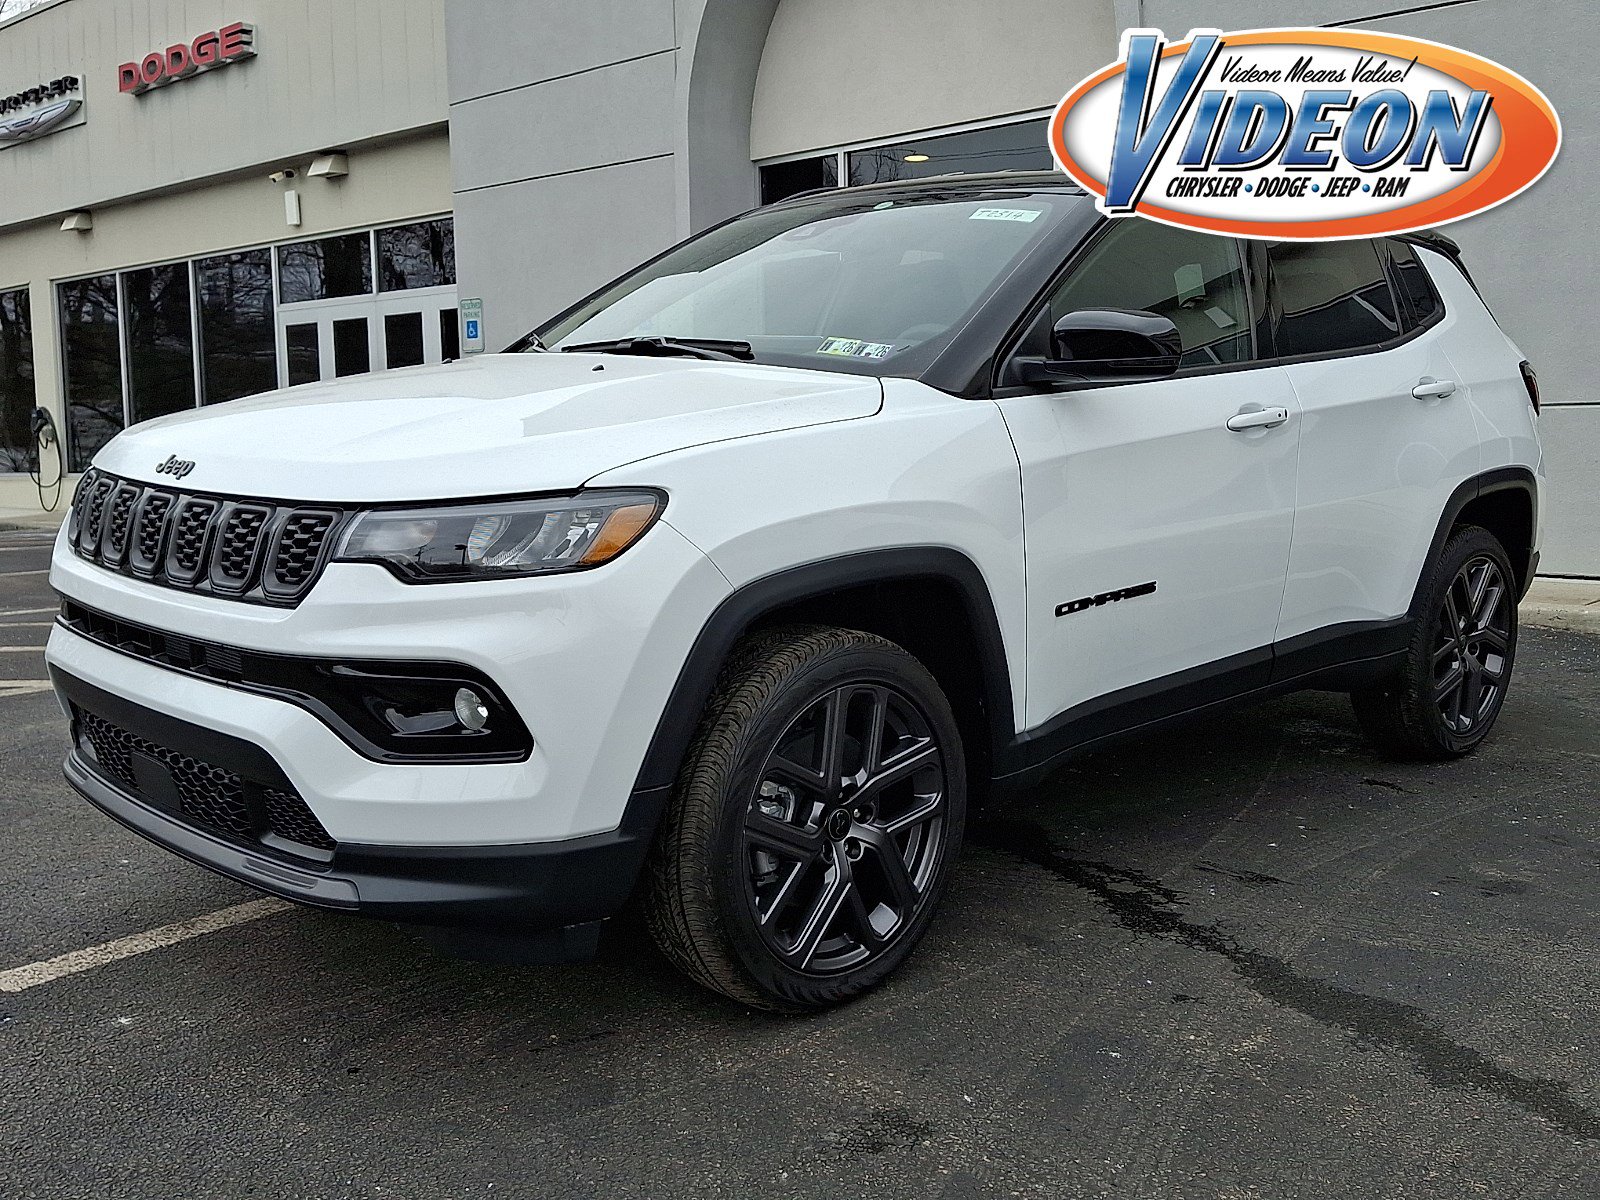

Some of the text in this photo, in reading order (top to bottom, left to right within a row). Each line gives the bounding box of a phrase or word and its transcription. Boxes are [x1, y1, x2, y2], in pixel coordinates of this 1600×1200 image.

[118, 22, 251, 93] DODGE
[155, 454, 196, 480] Jeep
[1054, 580, 1157, 618] COMPA
